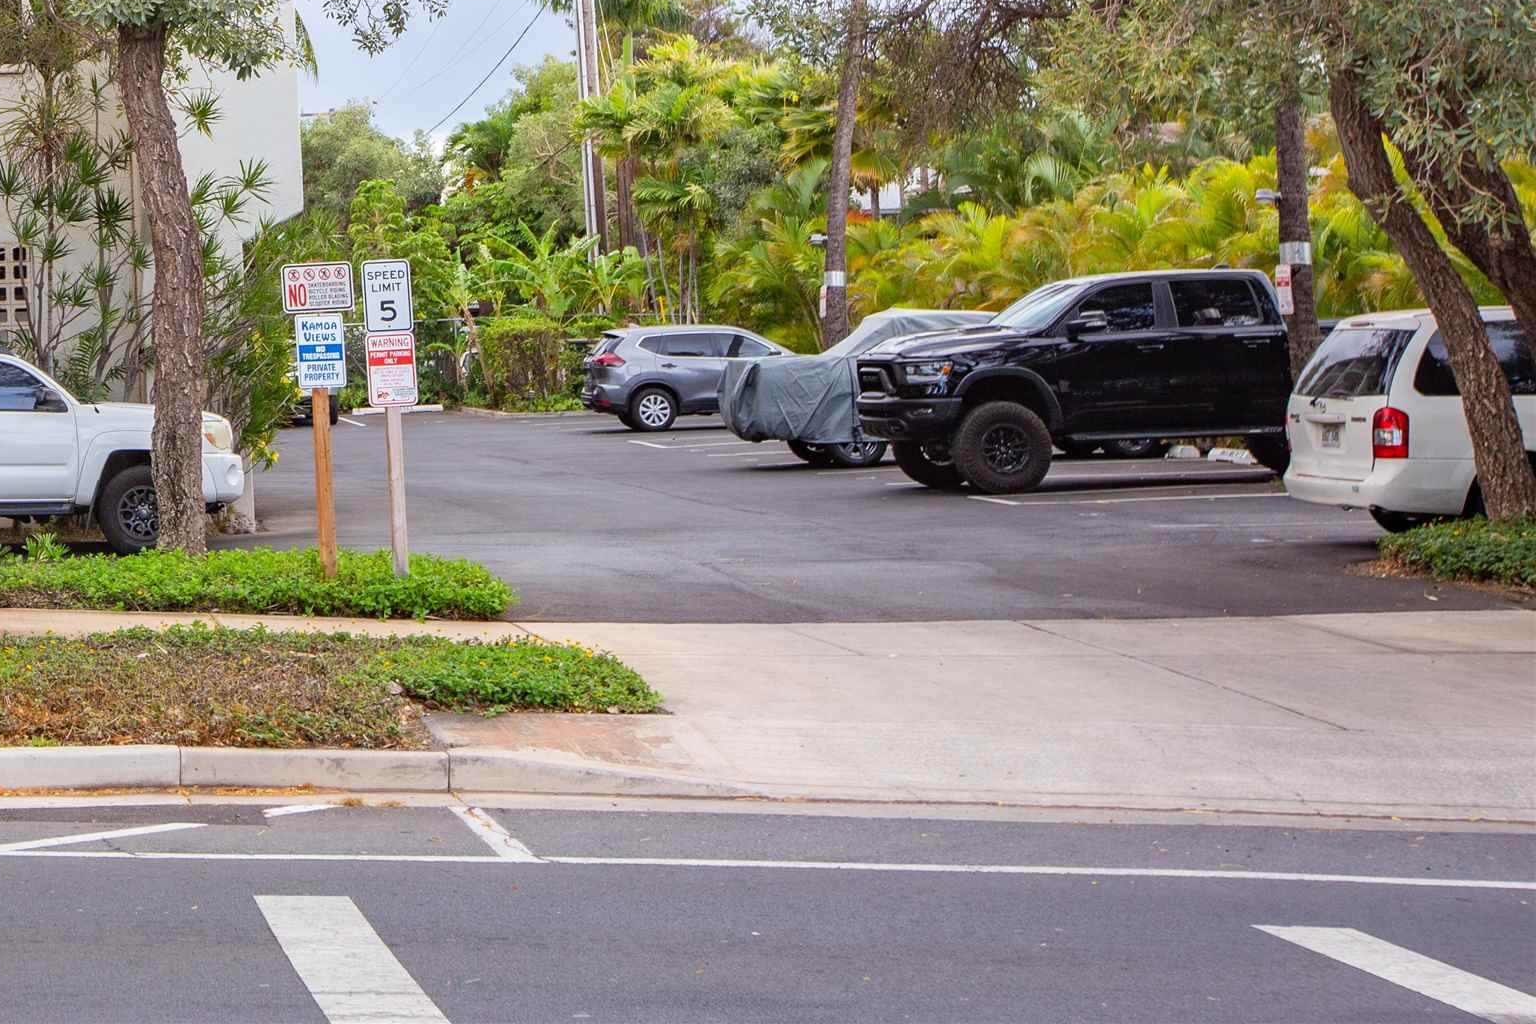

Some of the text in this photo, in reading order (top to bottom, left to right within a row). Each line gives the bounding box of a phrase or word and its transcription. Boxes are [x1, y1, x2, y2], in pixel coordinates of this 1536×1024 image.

[367, 270, 405, 280] SPEED
[371, 282, 401, 293] LIMIT
[288, 283, 307, 307] NO
[380, 300, 397, 321] 5
[303, 332, 336, 342] VIEWS
[370, 337, 409, 349] WARNING
[389, 350, 412, 358] PARKING
[307, 363, 337, 372] PRIVATE
[304, 373, 339, 381] PROPERTY
